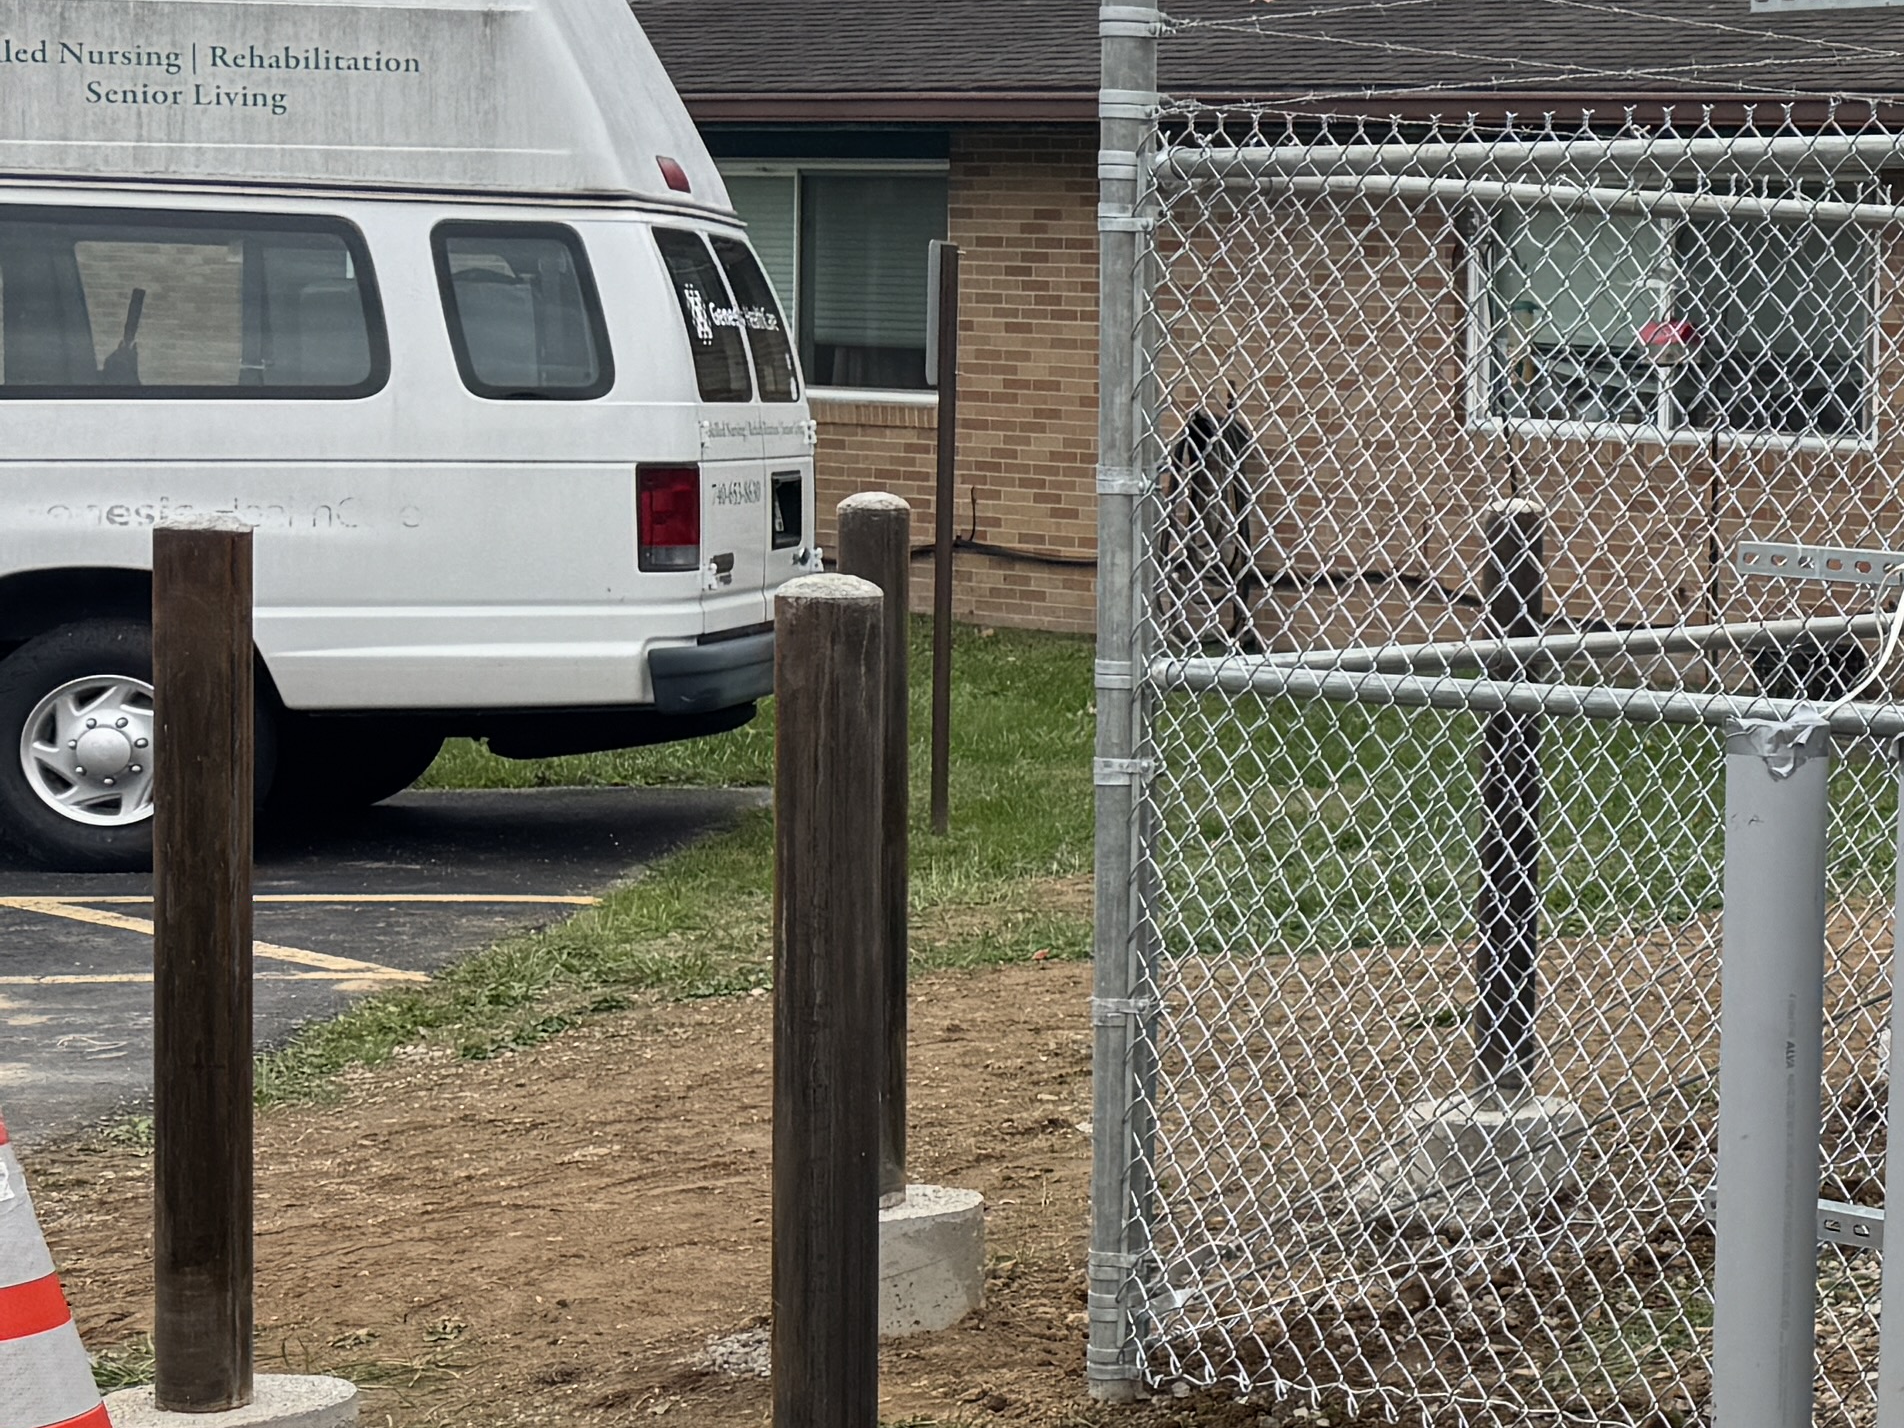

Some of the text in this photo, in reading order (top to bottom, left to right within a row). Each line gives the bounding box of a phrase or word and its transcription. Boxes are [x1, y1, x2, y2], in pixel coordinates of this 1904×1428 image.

[0, 39, 47, 64] led
[59, 41, 182, 75] Nursing
[210, 45, 420, 73] Rehabilitation
[86, 80, 287, 115] Senior Living
